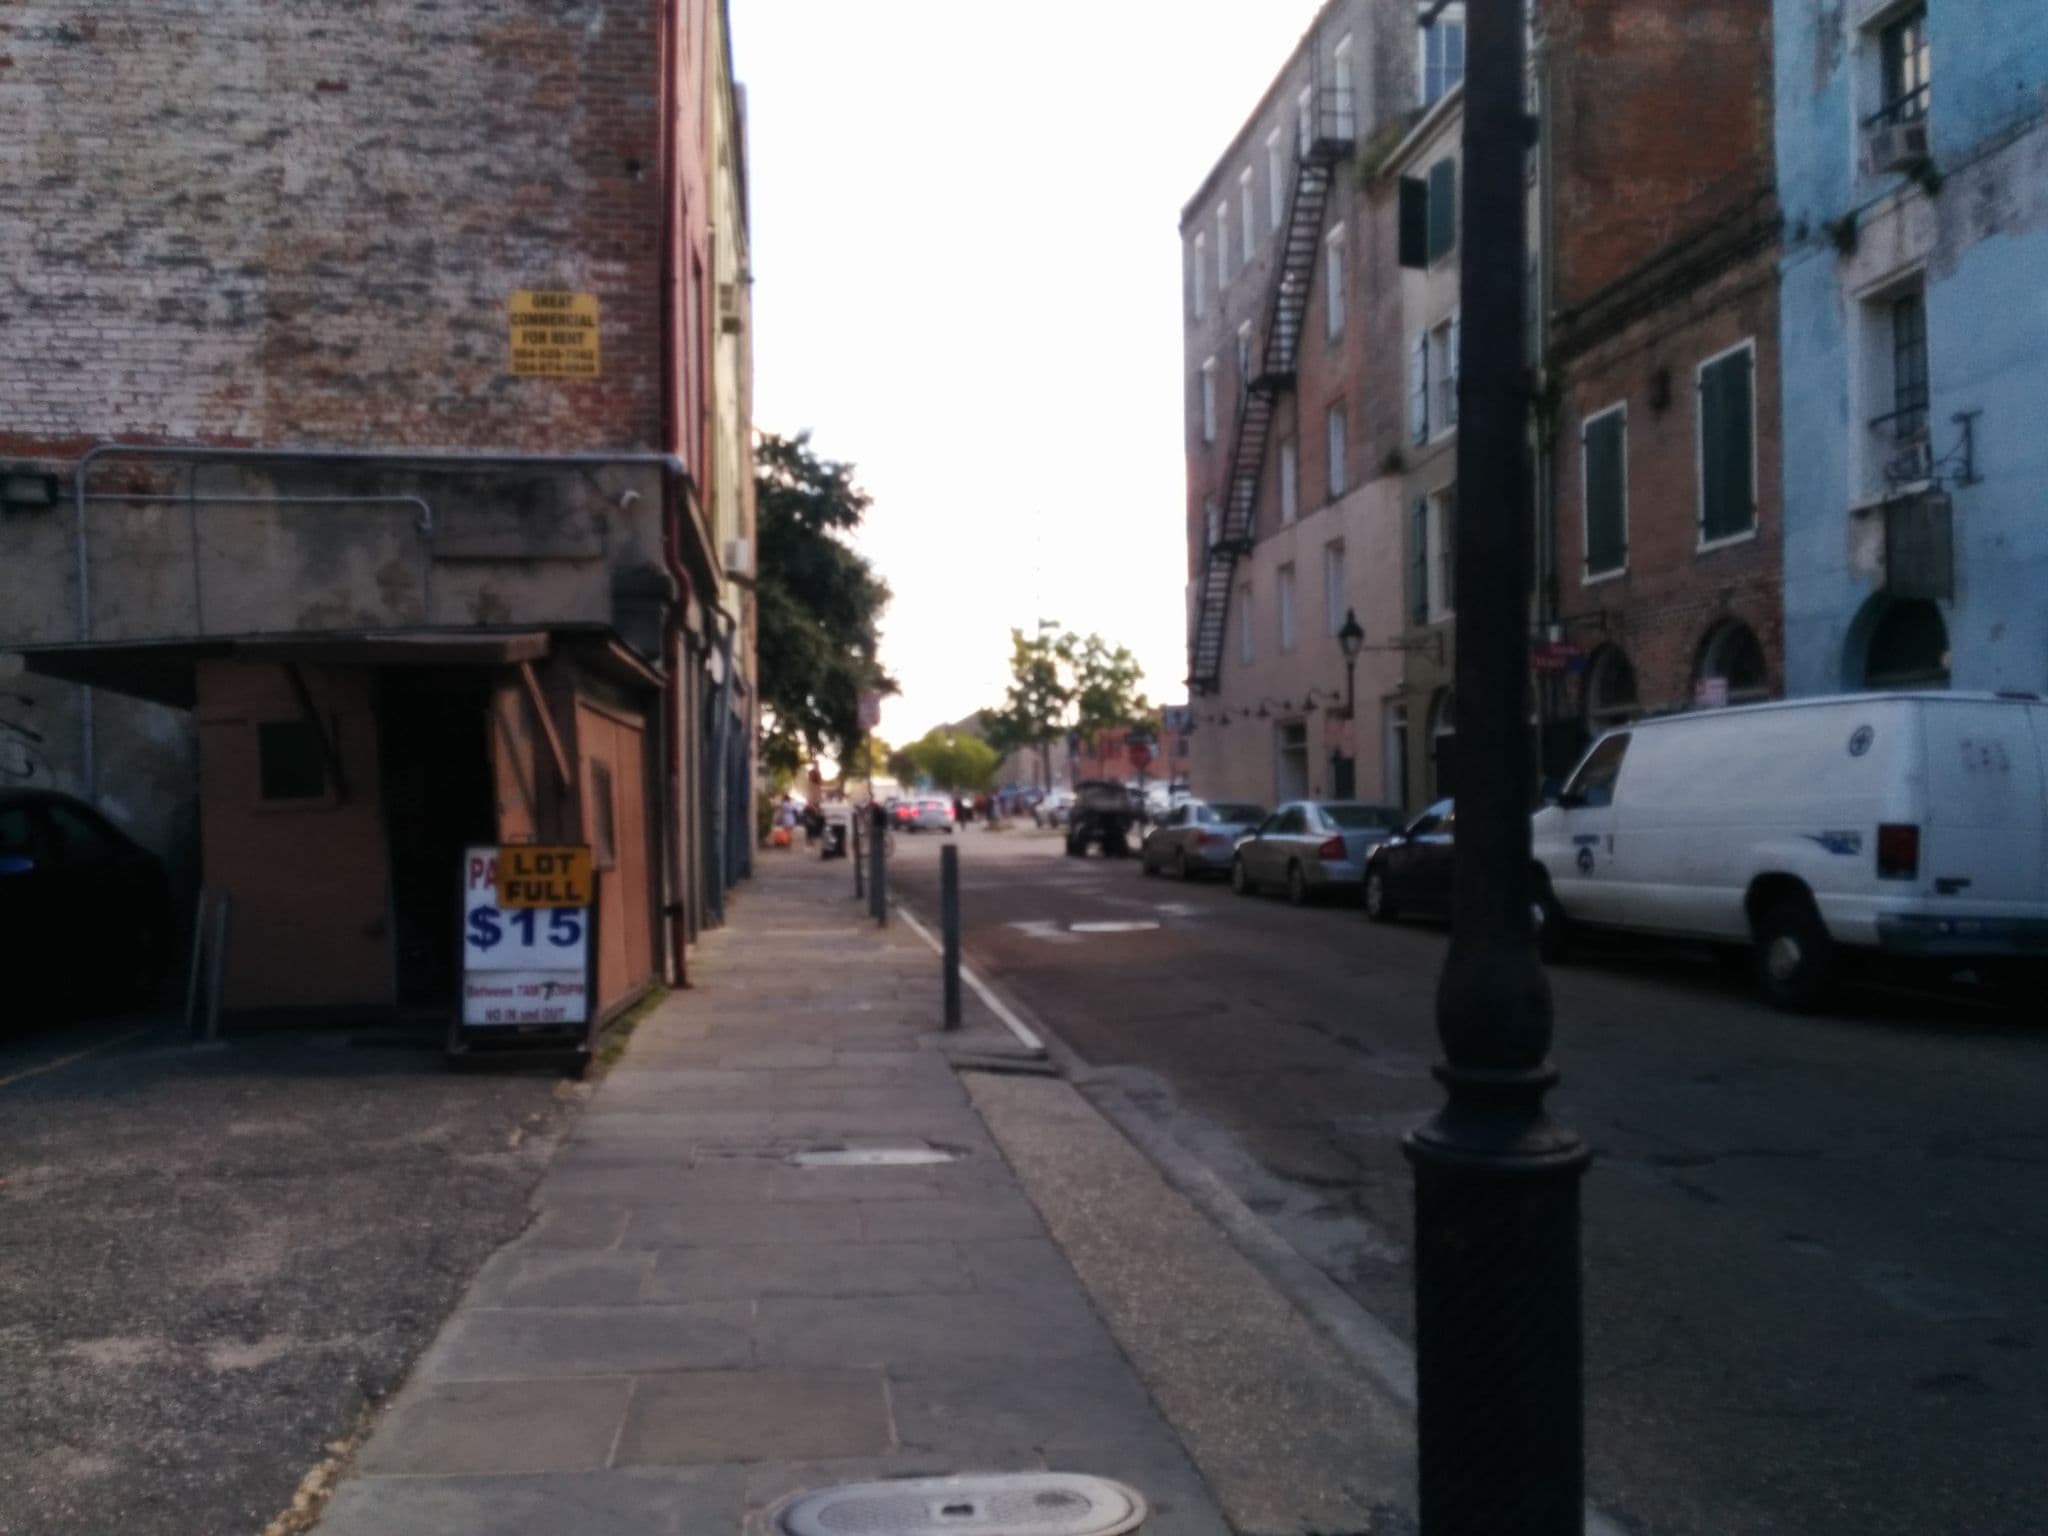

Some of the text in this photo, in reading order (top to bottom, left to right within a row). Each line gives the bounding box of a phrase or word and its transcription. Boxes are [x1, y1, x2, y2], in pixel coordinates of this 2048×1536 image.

[511, 312, 595, 327] COMMERCIAL
[522, 331, 584, 344] FOR RENT
[513, 853, 575, 875] LOT
[505, 880, 582, 902] FULL
[466, 905, 581, 952] $15
[485, 1008, 501, 1021] NO
[504, 1008, 516, 1021] IN
[543, 1007, 566, 1020] OUT
